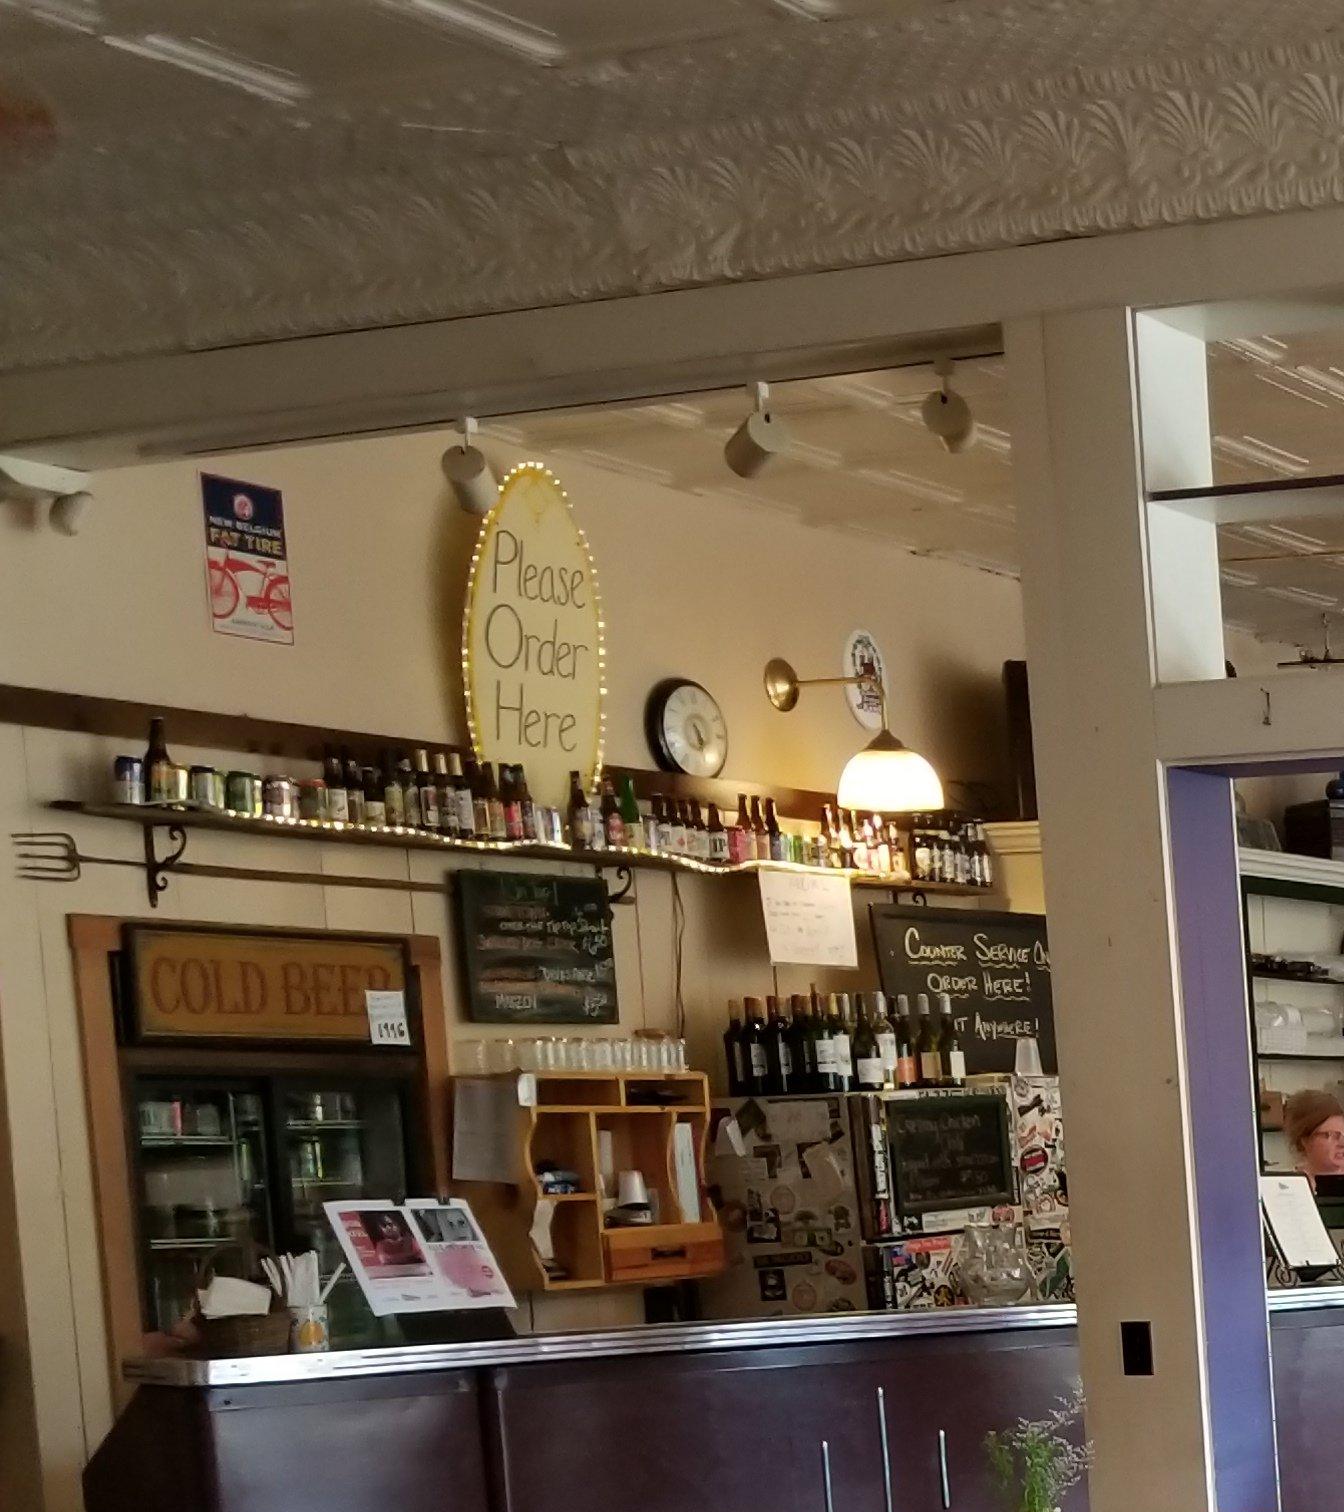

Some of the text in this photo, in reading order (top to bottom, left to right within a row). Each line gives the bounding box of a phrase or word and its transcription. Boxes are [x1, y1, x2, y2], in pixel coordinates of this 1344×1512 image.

[209, 515, 282, 538] NEW BELGIUM
[210, 527, 283, 555] FAT TIRE
[493, 529, 586, 609] Please
[486, 603, 589, 680] Order
[496, 679, 577, 752] Here
[151, 956, 269, 1015] COLD
